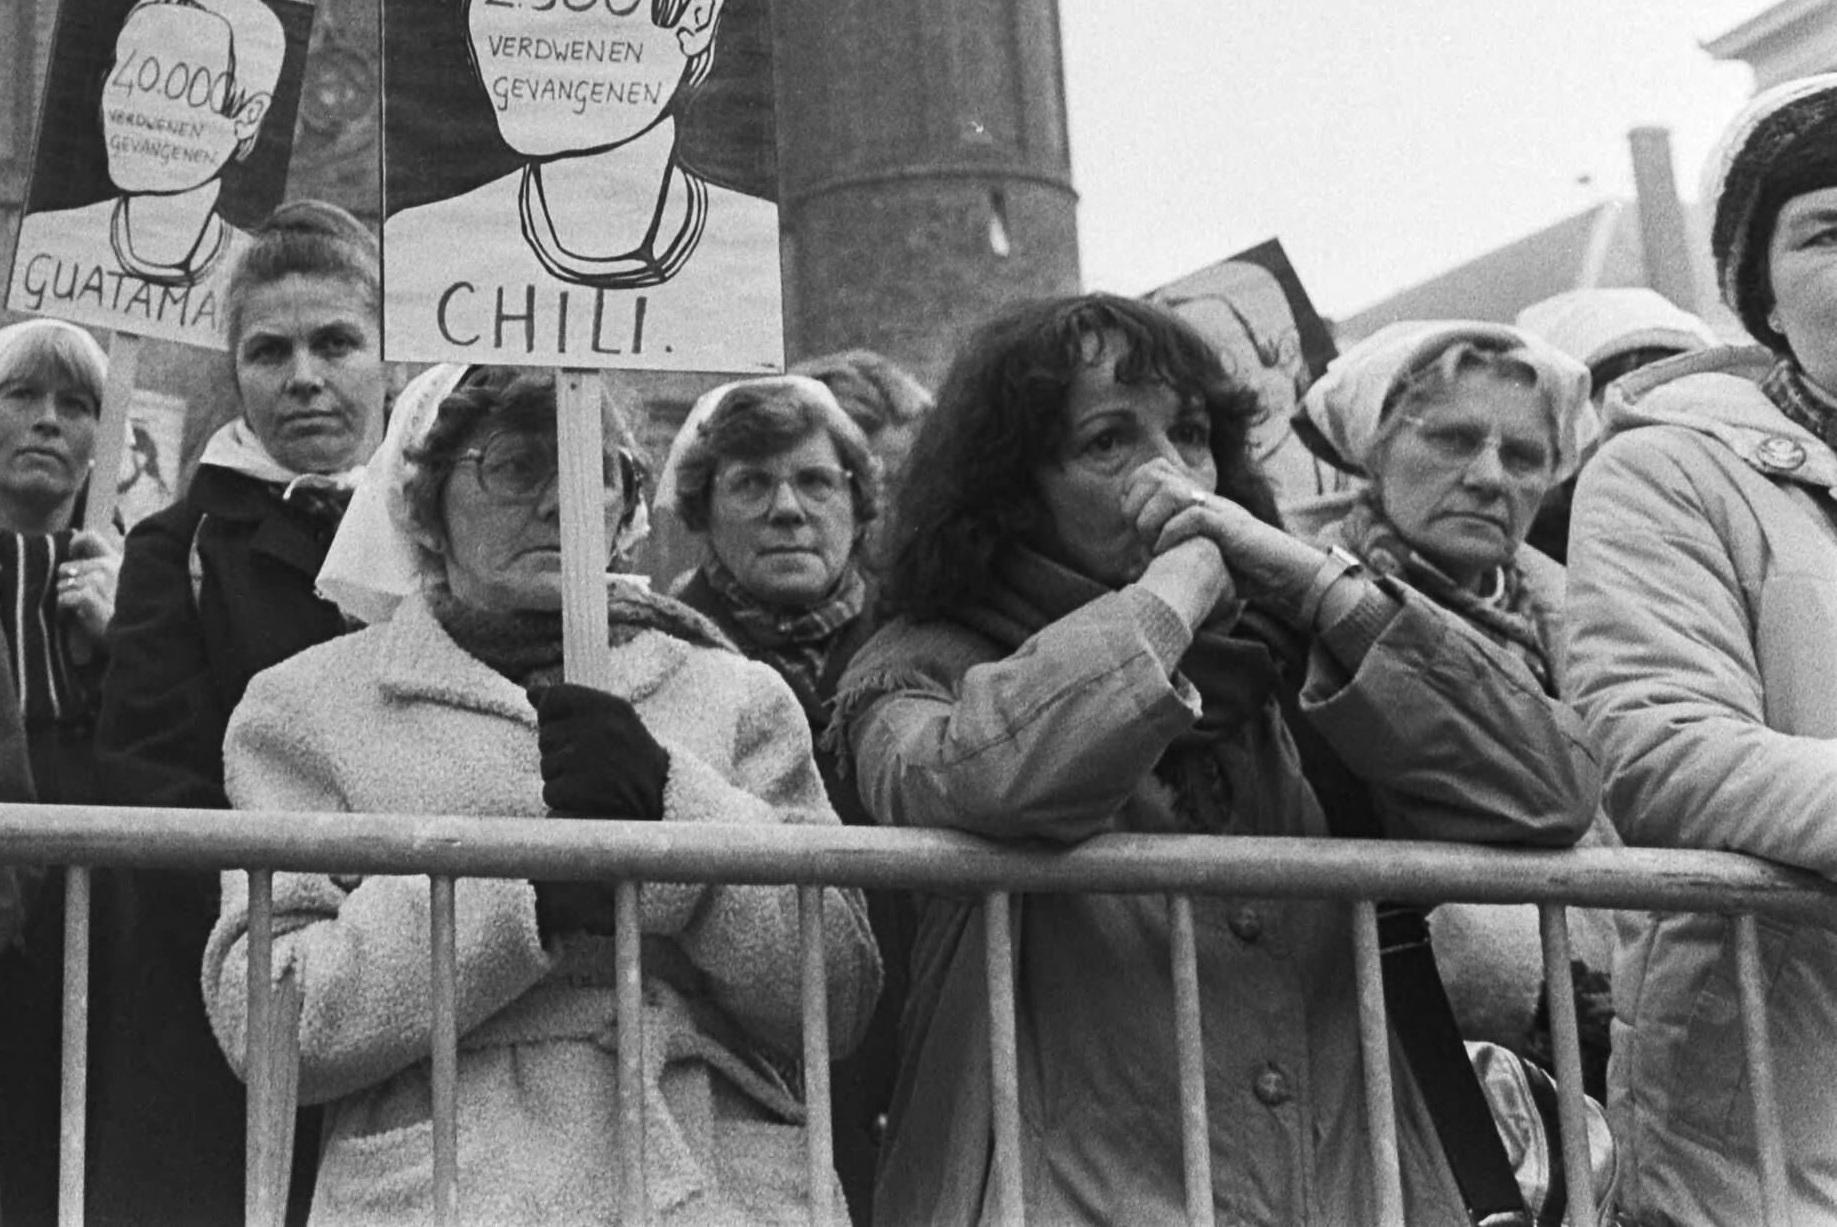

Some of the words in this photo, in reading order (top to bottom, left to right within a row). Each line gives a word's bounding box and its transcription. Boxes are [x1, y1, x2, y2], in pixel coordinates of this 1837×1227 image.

[488, 35, 644, 64] VERDWENEN
[112, 49, 238, 115] 40.000
[492, 76, 663, 115] GEVANGENEN
[109, 135, 219, 165] GEVANGENEN
[436, 280, 674, 355] CHILI.
